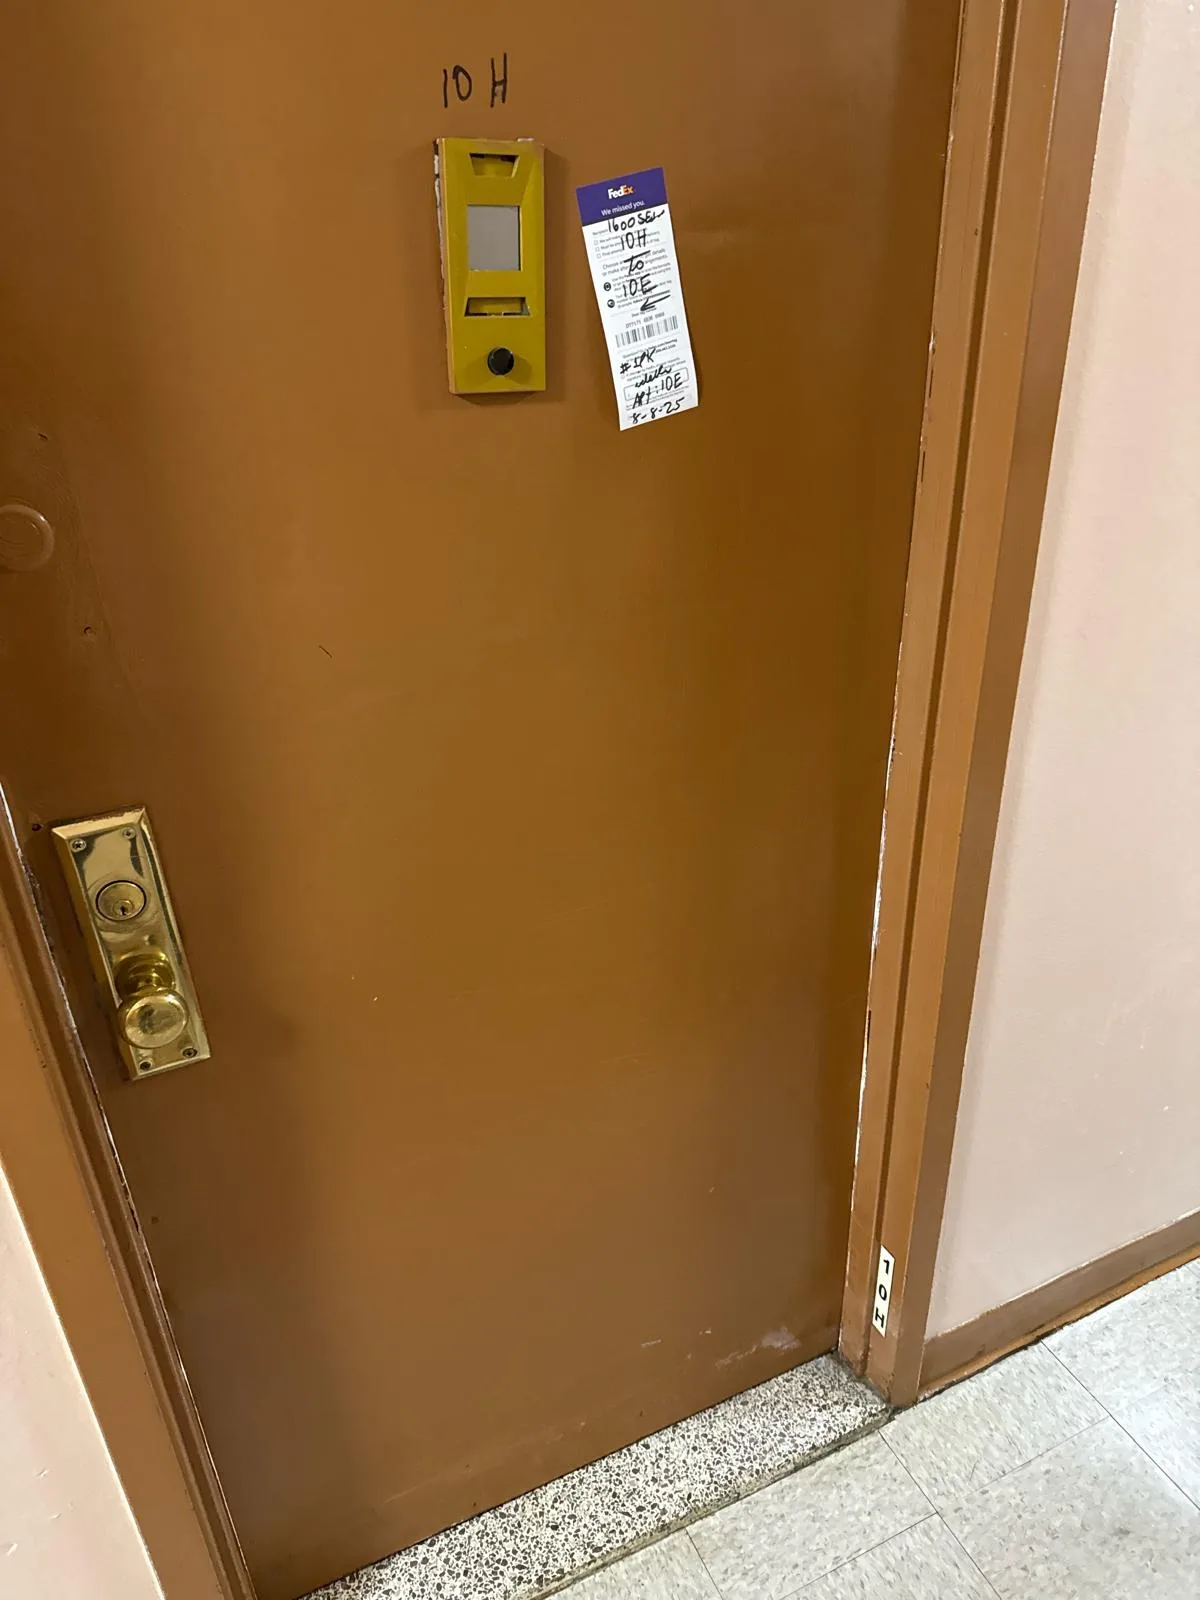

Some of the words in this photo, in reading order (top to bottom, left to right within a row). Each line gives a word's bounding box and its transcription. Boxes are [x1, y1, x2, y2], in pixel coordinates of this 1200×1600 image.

[442, 64, 472, 109] 10
[490, 52, 508, 108] H
[607, 184, 634, 199] FedEx
[600, 207, 611, 216] We
[612, 202, 632, 213] missed
[607, 217, 636, 233] 1600
[620, 228, 647, 251] 10H
[622, 273, 658, 297] 10E
[874, 1259, 890, 1329] 10H
